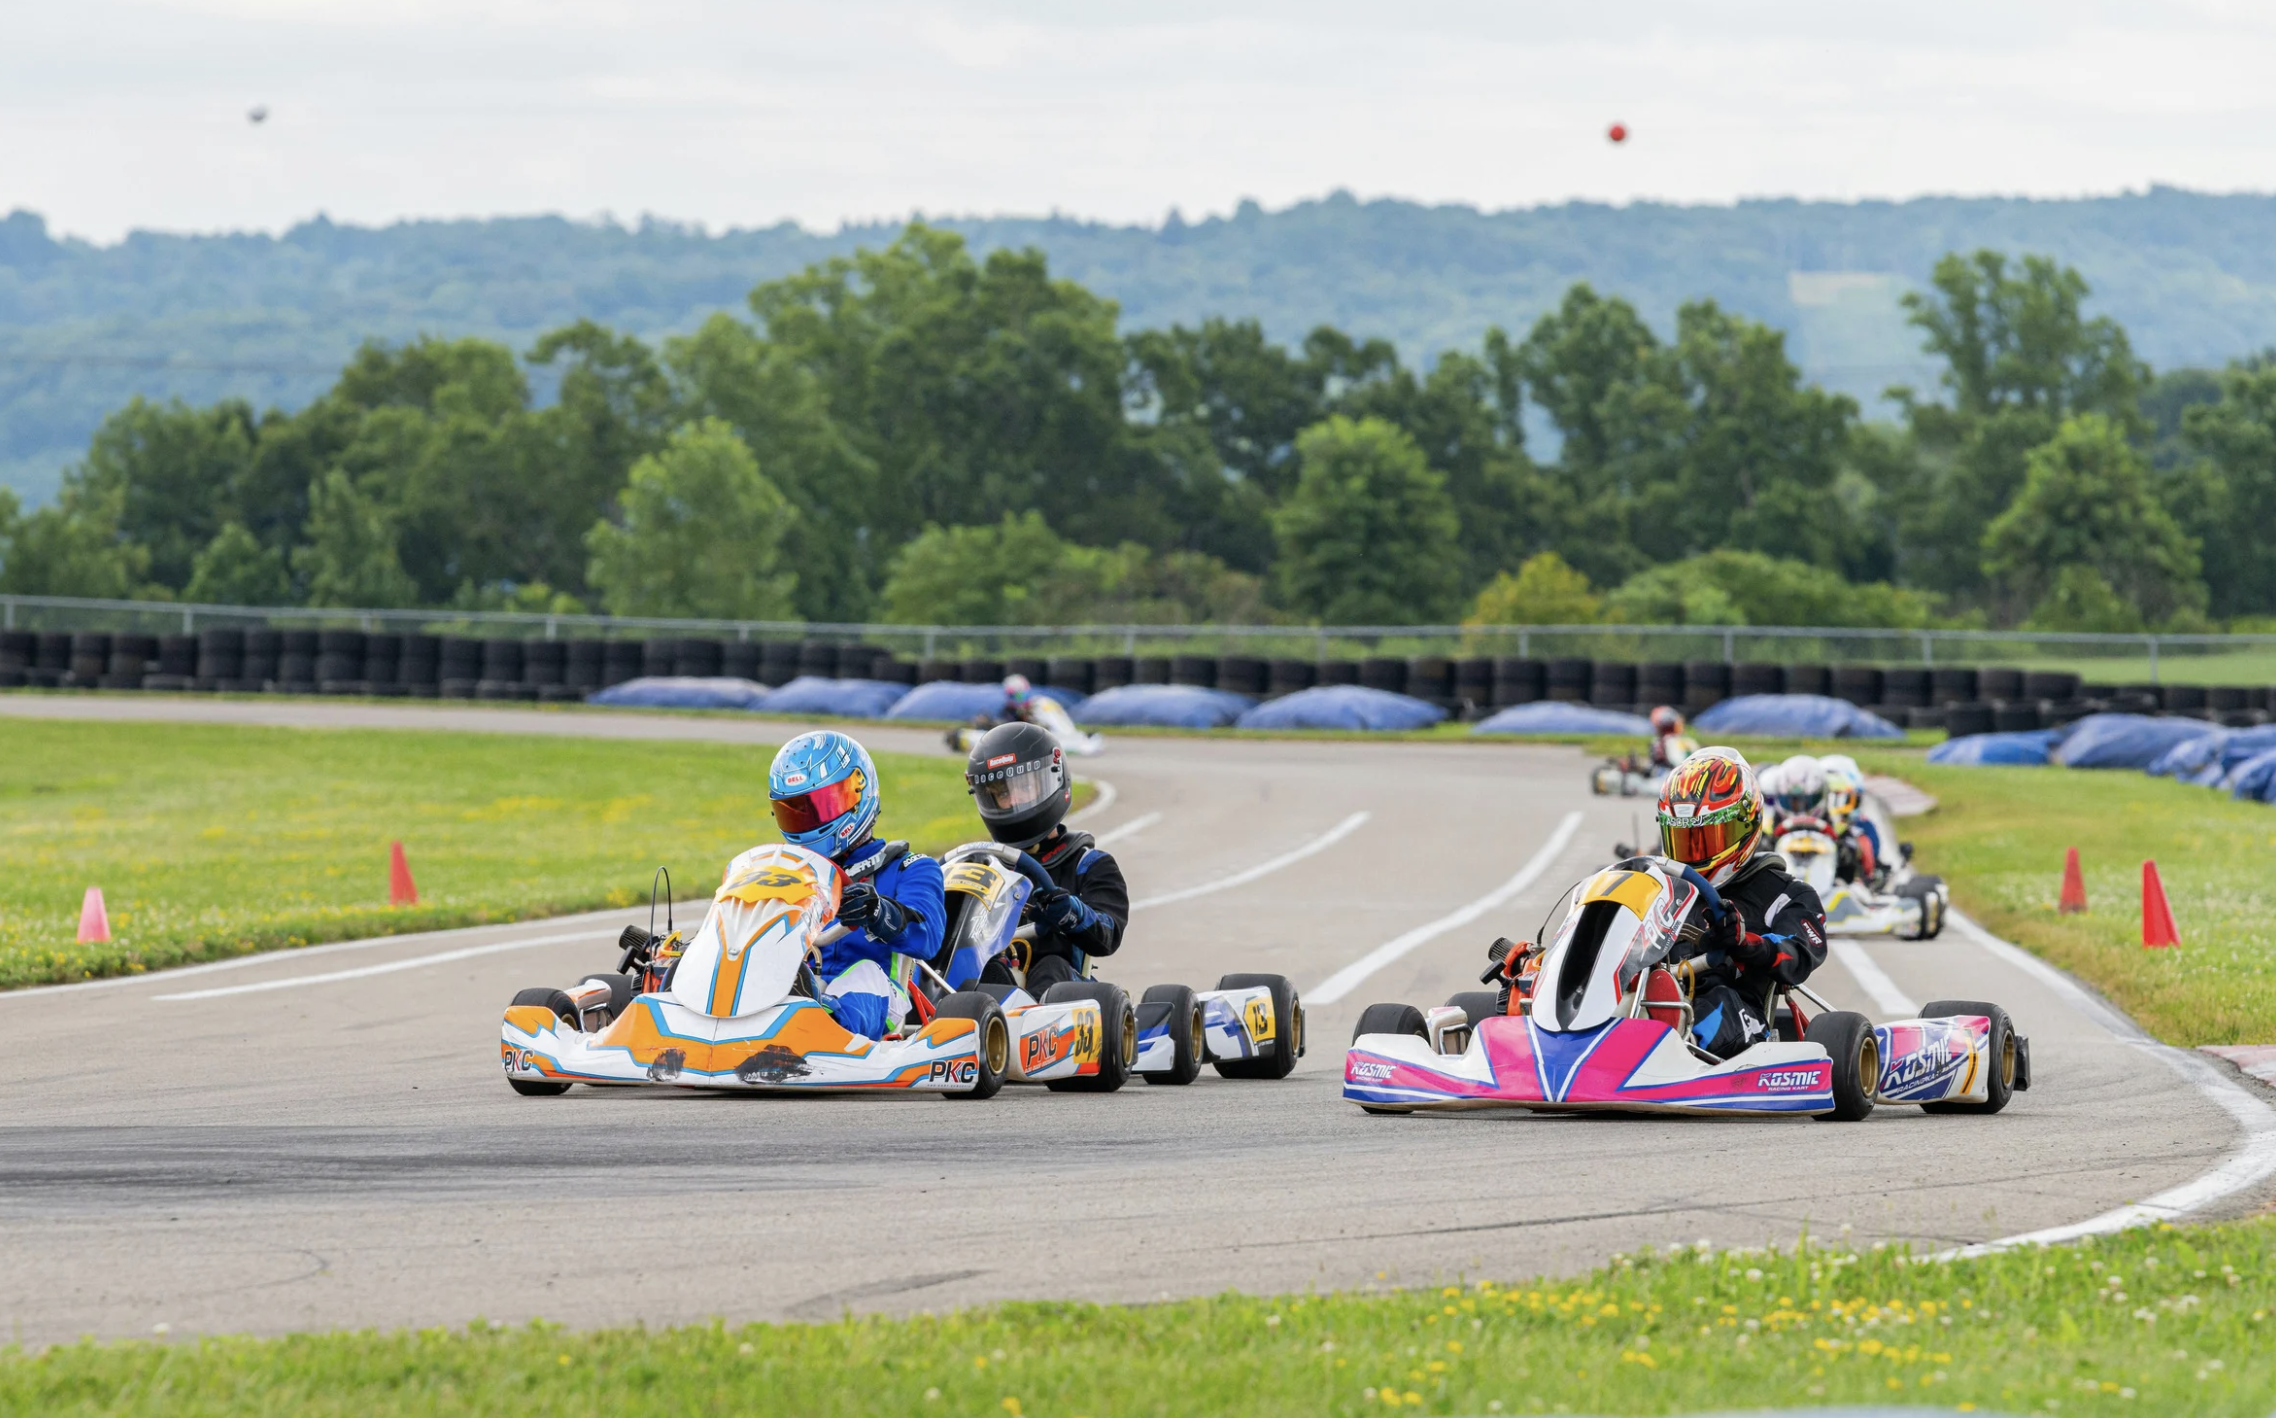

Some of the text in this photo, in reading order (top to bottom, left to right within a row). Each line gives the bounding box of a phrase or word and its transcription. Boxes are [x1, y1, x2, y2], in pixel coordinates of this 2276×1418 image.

[787, 775, 804, 783] BELL
[840, 824, 854, 837] BELL
[1252, 1003, 1268, 1036] 13
[1075, 1010, 1095, 1057] 33
[1027, 1026, 1057, 1067] PKC
[504, 1050, 533, 1072] PKC
[929, 1061, 976, 1083] PKC
[1757, 1070, 1822, 1087] KOSMIC
